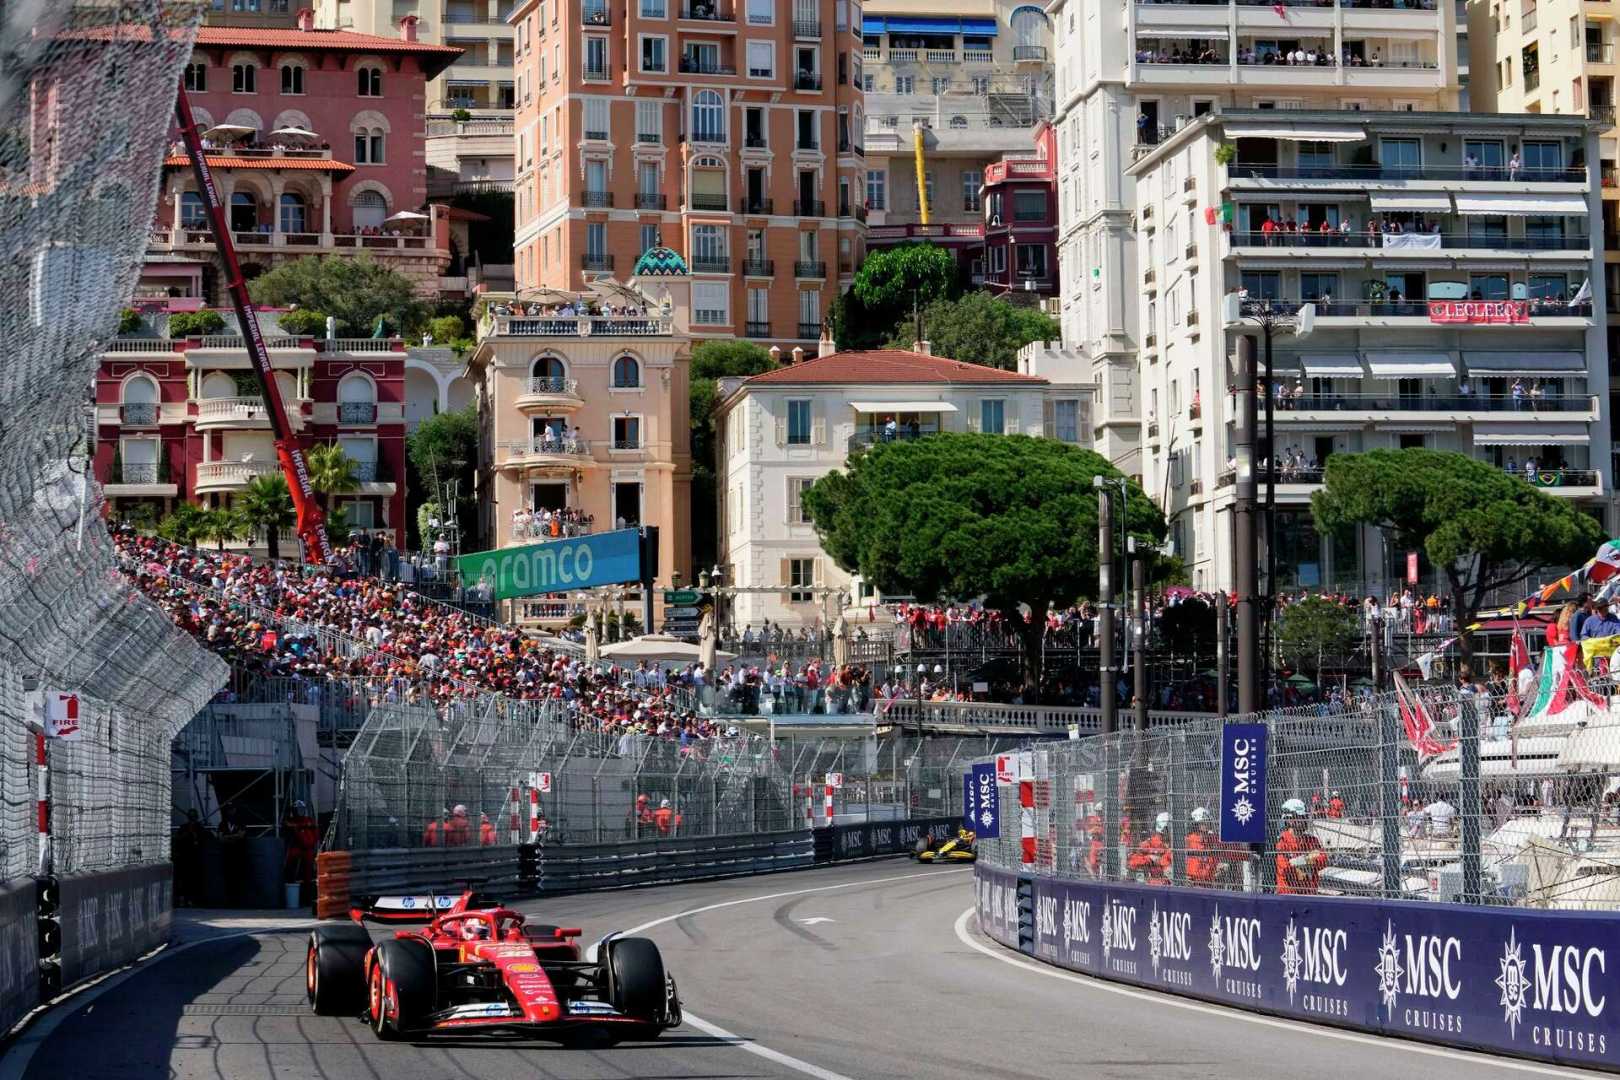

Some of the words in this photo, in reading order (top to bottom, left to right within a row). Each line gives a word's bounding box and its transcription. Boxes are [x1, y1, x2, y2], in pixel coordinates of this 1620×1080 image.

[244, 305, 259, 341] IMPERIAL
[291, 449, 312, 498] IMPERIAL
[1234, 738, 1249, 794] MSC
[980, 774, 991, 809] MSC
[847, 832, 863, 848] MSC
[877, 828, 892, 845] MSC
[906, 825, 921, 842] MSC
[1042, 895, 1057, 936] MSC
[1071, 901, 1090, 943] MSC
[1112, 904, 1136, 951] MSC
[1163, 911, 1191, 960] MSC
[1225, 916, 1261, 971] MSC
[1303, 927, 1347, 986] MSC
[1405, 934, 1461, 1000] MSC
[1163, 968, 1192, 986] CRUISES
[1226, 978, 1261, 999] CRUISES
[1533, 944, 1605, 1017] MSC
[1303, 995, 1348, 1016] CRUISES
[1405, 1009, 1462, 1033] CRUISES
[1533, 1026, 1605, 1054] CRUISES
